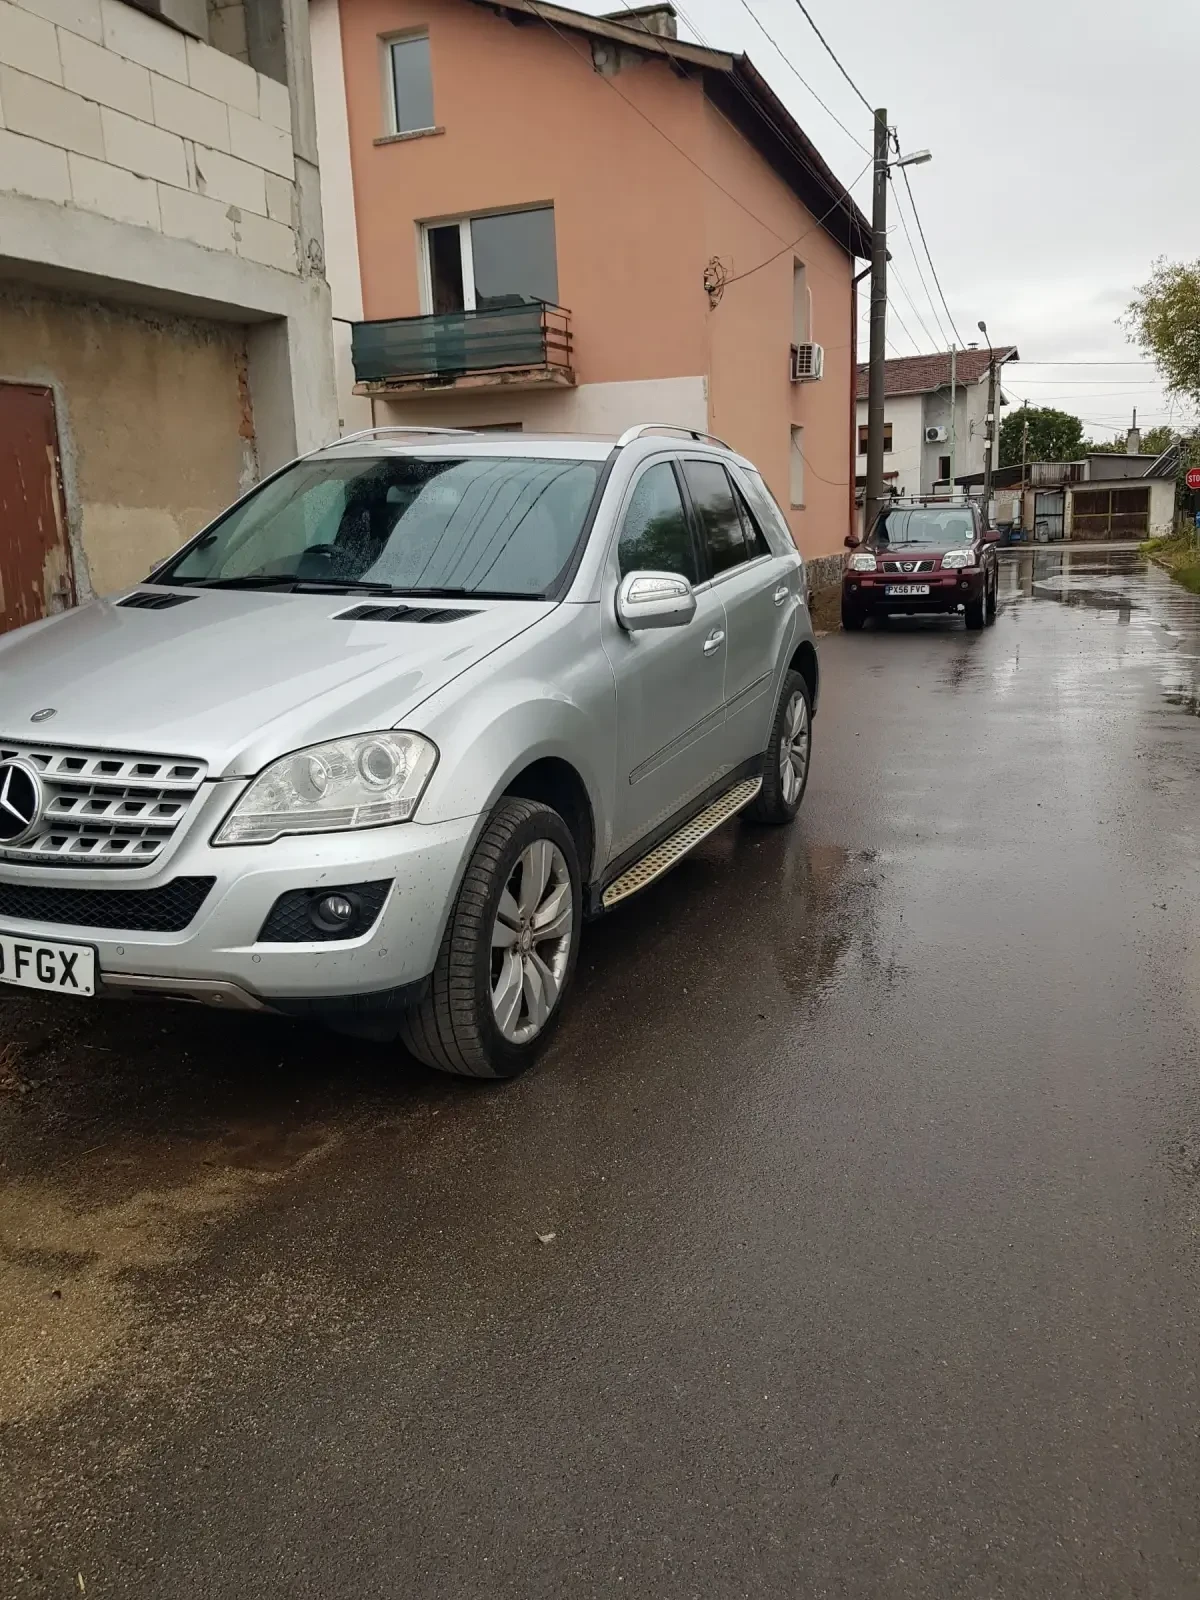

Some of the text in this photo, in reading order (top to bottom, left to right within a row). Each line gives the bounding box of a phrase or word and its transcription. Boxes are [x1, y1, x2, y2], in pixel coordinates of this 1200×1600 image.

[889, 585, 925, 593] PX56 FVC
[15, 944, 78, 988] FGX
